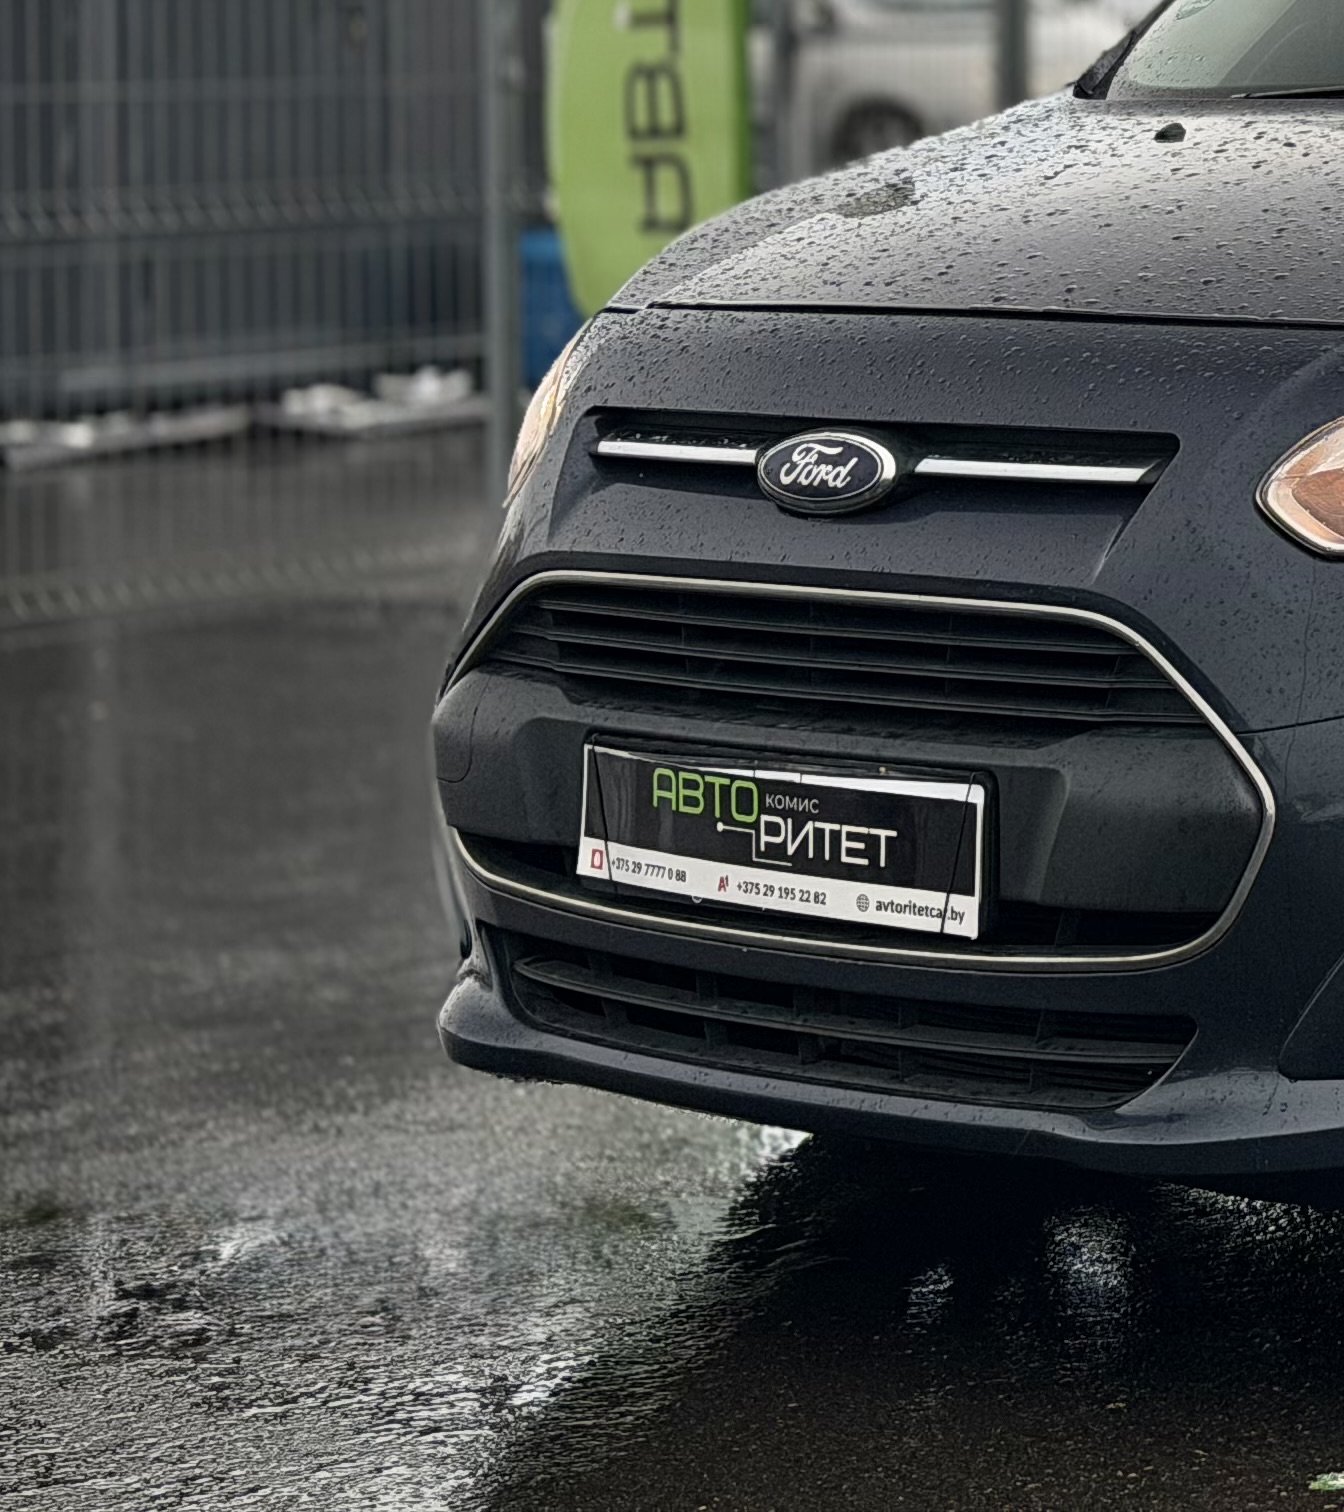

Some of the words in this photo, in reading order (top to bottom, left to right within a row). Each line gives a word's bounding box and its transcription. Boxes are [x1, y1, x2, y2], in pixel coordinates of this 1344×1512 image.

[780, 443, 858, 488] Ford
[652, 767, 759, 823] АВТО
[765, 793, 819, 814] КОМИС
[760, 814, 898, 868] РИТЕТ
[611, 857, 630, 873] +375
[631, 861, 643, 875] 29
[644, 864, 666, 879] 7777
[667, 868, 674, 880] 0
[675, 869, 687, 883] 88
[737, 881, 760, 896] +375
[763, 884, 775, 898] 29
[778, 886, 796, 901] 195
[799, 889, 811, 903] 22
[814, 891, 827, 905] 82
[875, 899, 965, 926] avtoritetca.by
